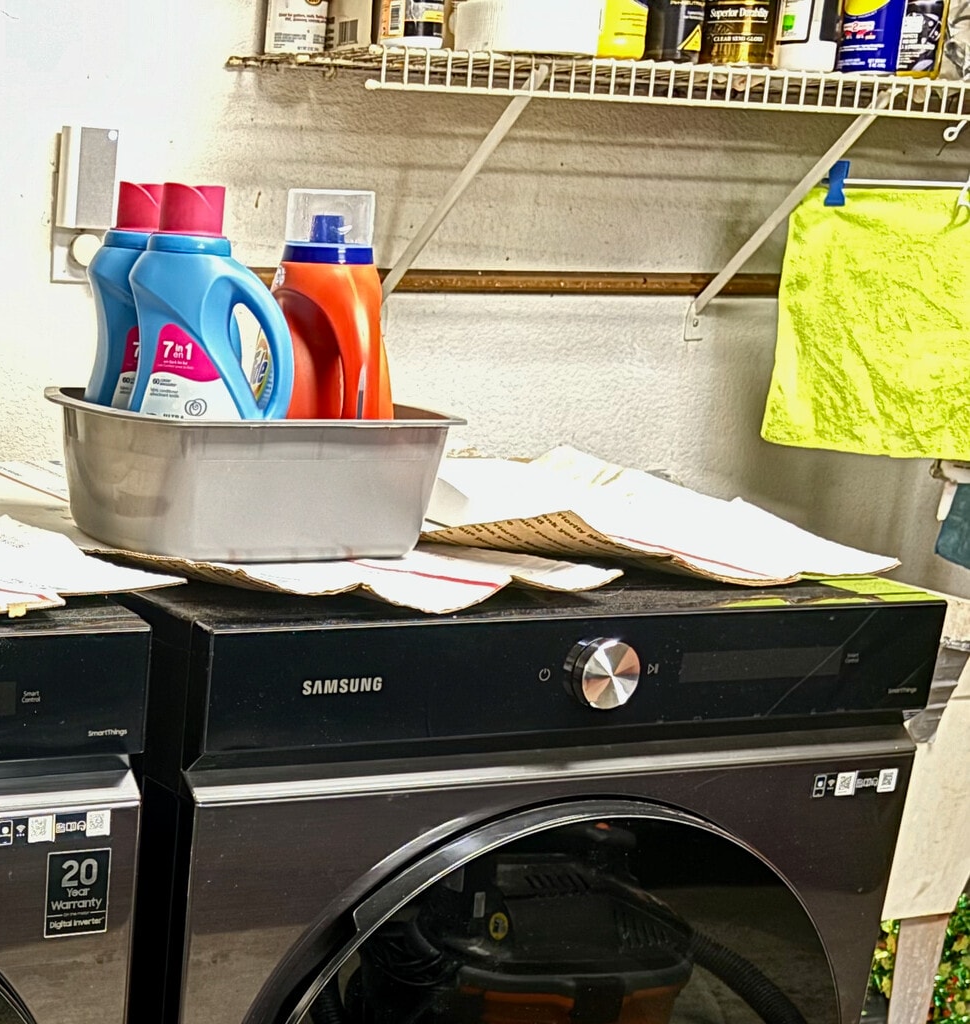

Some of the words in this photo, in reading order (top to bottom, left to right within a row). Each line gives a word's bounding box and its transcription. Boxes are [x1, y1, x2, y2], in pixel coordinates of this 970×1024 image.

[710, 7, 738, 20] Superior
[163, 340, 174, 358] 7
[175, 344, 184, 352] in
[185, 342, 193, 360] 1
[302, 677, 383, 696] SAMSUNG
[88, 728, 128, 737] SmartThings
[61, 858, 98, 888] 20
[66, 888, 90, 898] Year
[51, 897, 103, 911] Warranty
[49, 919, 73, 930] Digital
